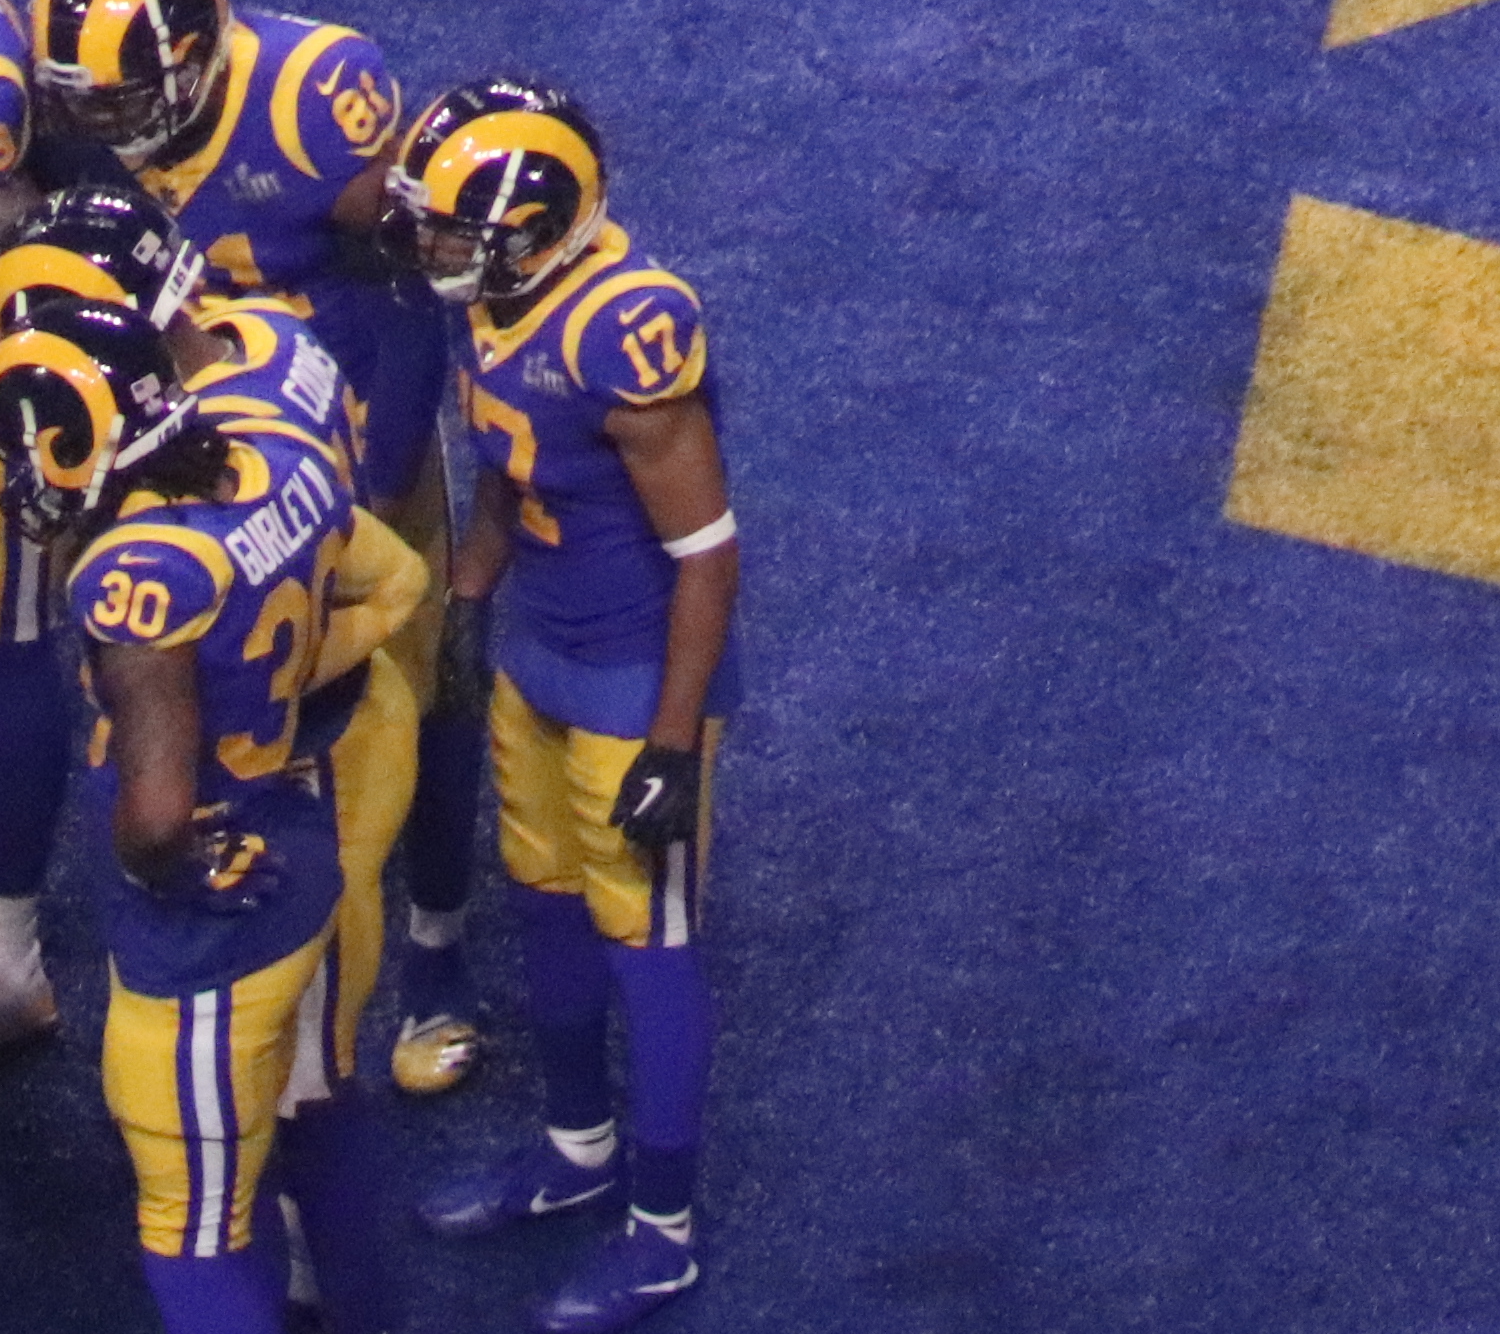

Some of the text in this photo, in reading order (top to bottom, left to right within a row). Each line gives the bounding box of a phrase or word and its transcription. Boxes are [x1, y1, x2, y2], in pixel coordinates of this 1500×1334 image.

[332, 69, 393, 144] 81
[622, 311, 684, 388] 17
[224, 472, 323, 586] GURLEY
[93, 570, 171, 638] 30
